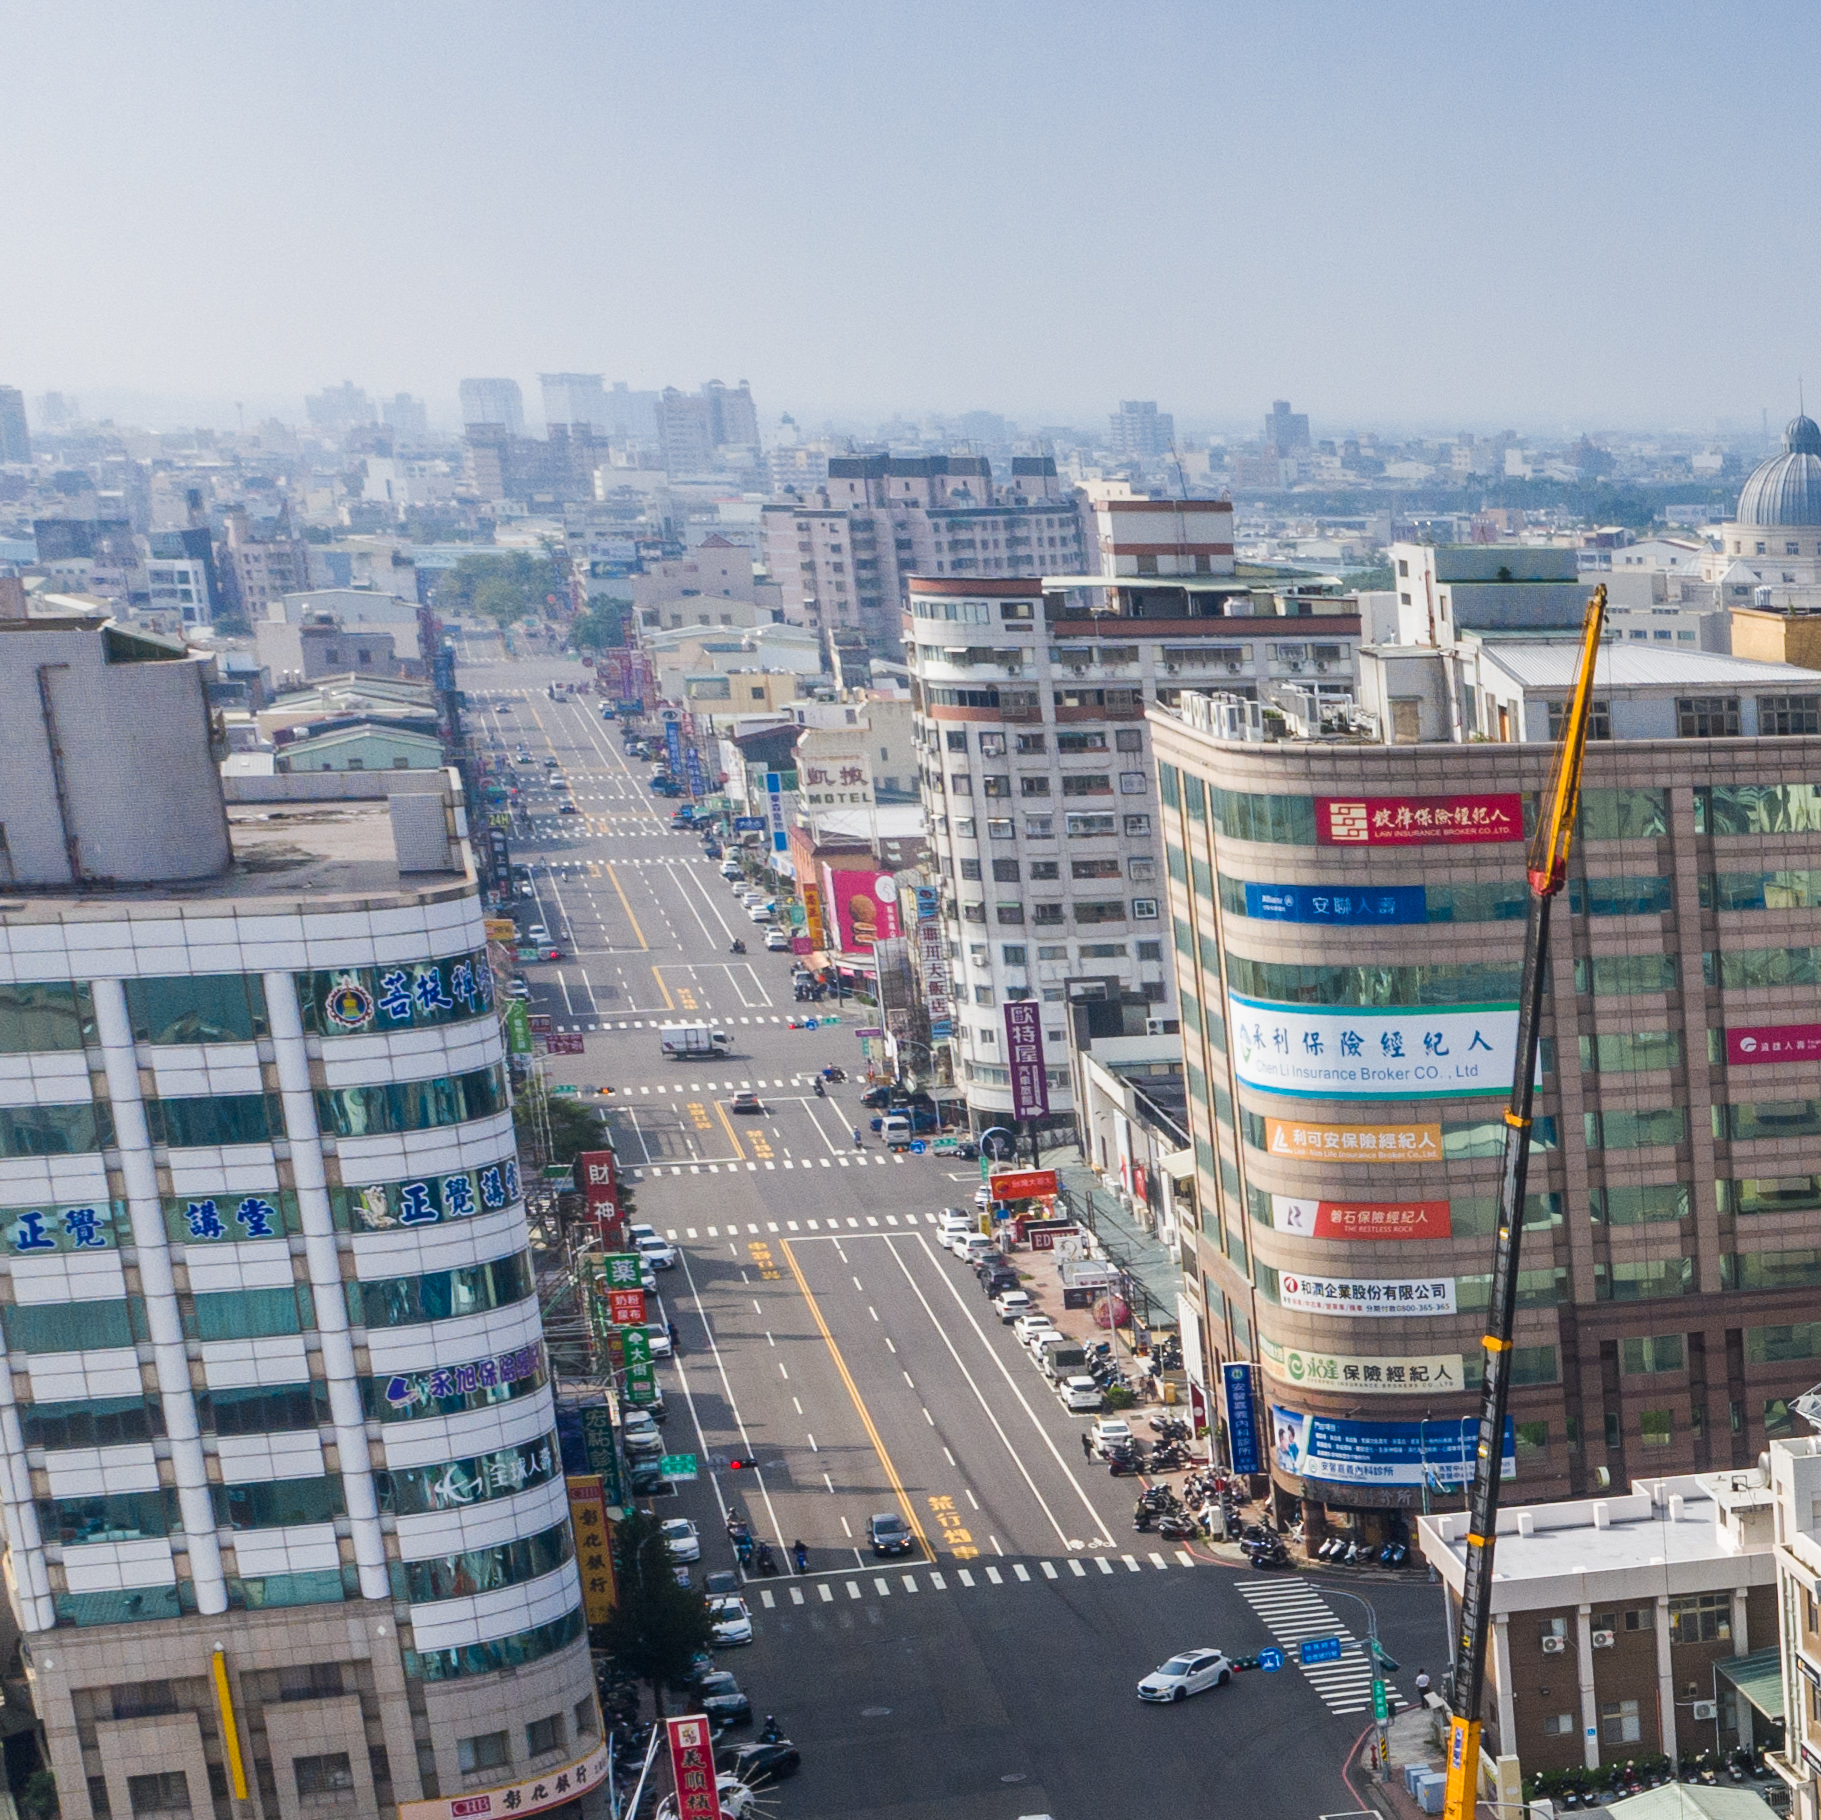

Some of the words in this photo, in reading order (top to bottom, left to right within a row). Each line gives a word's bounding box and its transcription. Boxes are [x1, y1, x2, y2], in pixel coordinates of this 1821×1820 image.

[809, 793, 872, 804] MOTEL
[1394, 829, 1440, 837] INSURANCE
[1444, 828, 1477, 836] BROKER
[1313, 897, 1396, 914] 安聯人壽
[1010, 1006, 1038, 1063] 歐特屋
[1256, 1061, 1278, 1075] Chen
[1281, 1064, 1289, 1076] Li
[1292, 1066, 1356, 1080] Insurance
[1362, 1066, 1409, 1080] Broker
[1457, 1064, 1479, 1078] Ltd
[1293, 1129, 1436, 1149] 利可安保險經紀人
[400, 1160, 520, 1226] 正覺講堂
[589, 1164, 615, 1221] 財神
[1330, 1209, 1428, 1225] 磐石保險經紀人
[1301, 1281, 1446, 1300] 和潤企業股份有限公司
[1307, 1357, 1452, 1382] 永達保險經紀人
[502, 1764, 588, 1810] 彰化銀行
